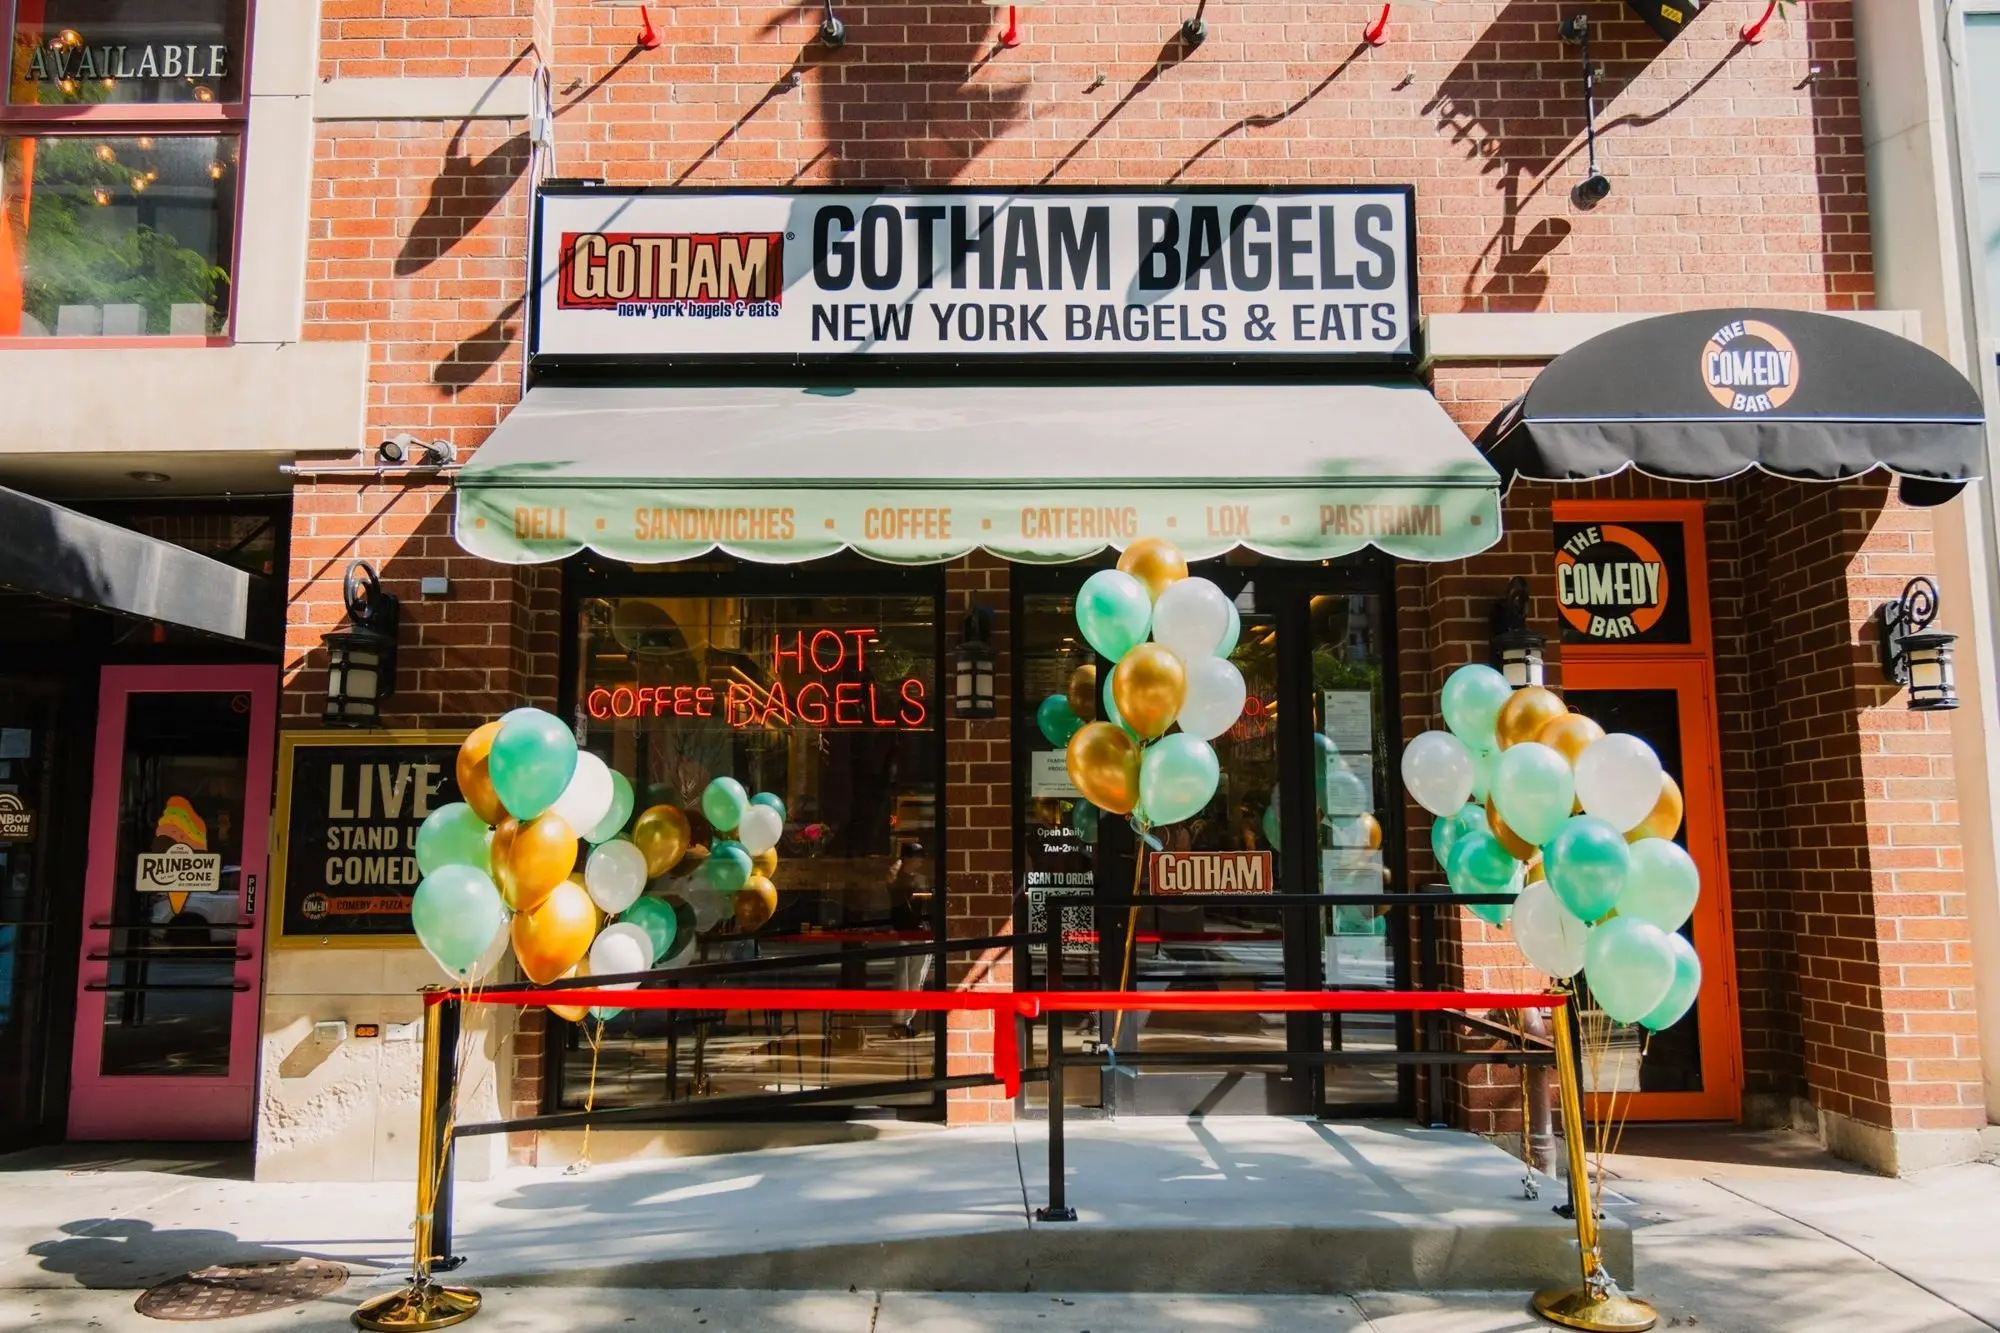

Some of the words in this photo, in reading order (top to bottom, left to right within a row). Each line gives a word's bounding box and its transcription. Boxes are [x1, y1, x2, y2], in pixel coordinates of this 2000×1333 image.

[25, 45, 228, 78] AVAILABLE
[813, 204, 1111, 291] GOTHAM
[1137, 203, 1397, 291] BAGELS
[618, 302, 648, 317] new
[652, 301, 685, 319] york
[688, 302, 732, 319] bagels
[735, 302, 745, 317] &
[748, 303, 779, 317] eats
[811, 303, 912, 342] NEW
[933, 303, 1049, 342] YORK
[1065, 303, 1228, 342] BAGELS
[1243, 303, 1277, 342] &
[1293, 302, 1397, 342] EATS
[1711, 320, 1744, 346] THE
[1706, 350, 1792, 386] COMEDY
[1732, 393, 1773, 412] BAR
[514, 507, 567, 540] DELI
[634, 507, 796, 540] SANDWICHES
[864, 507, 952, 540] COFFEE
[1021, 506, 1138, 539] CATERING
[1206, 505, 1250, 537] LOX
[1319, 504, 1442, 537] PASTRAMI
[1563, 526, 1601, 556] THE
[1557, 562, 1660, 606] COMEDY
[1590, 614, 1637, 639] BAR
[774, 628, 876, 674] HOT
[587, 685, 715, 720] COFFEE
[727, 678, 926, 728] BAGELS
[328, 764, 441, 819] LIVE
[3, 824, 29, 833] CONE
[326, 826, 399, 850] STAND
[1037, 826, 1061, 838] Open
[1062, 826, 1085, 838] Daily
[1043, 843, 1080, 853] 7AM-2PM
[142, 858, 216, 885] RAINBOW
[178, 871, 212, 882] CONE
[325, 856, 420, 886] COMED
[1027, 871, 1052, 885] SCAN
[1053, 872, 1064, 885] TO
[1065, 871, 1095, 885] ORDER
[1159, 854, 1263, 891] GOTHAM
[247, 877, 255, 911] PULL
[336, 900, 371, 911] COMEDY
[379, 900, 403, 911] PIZZA
